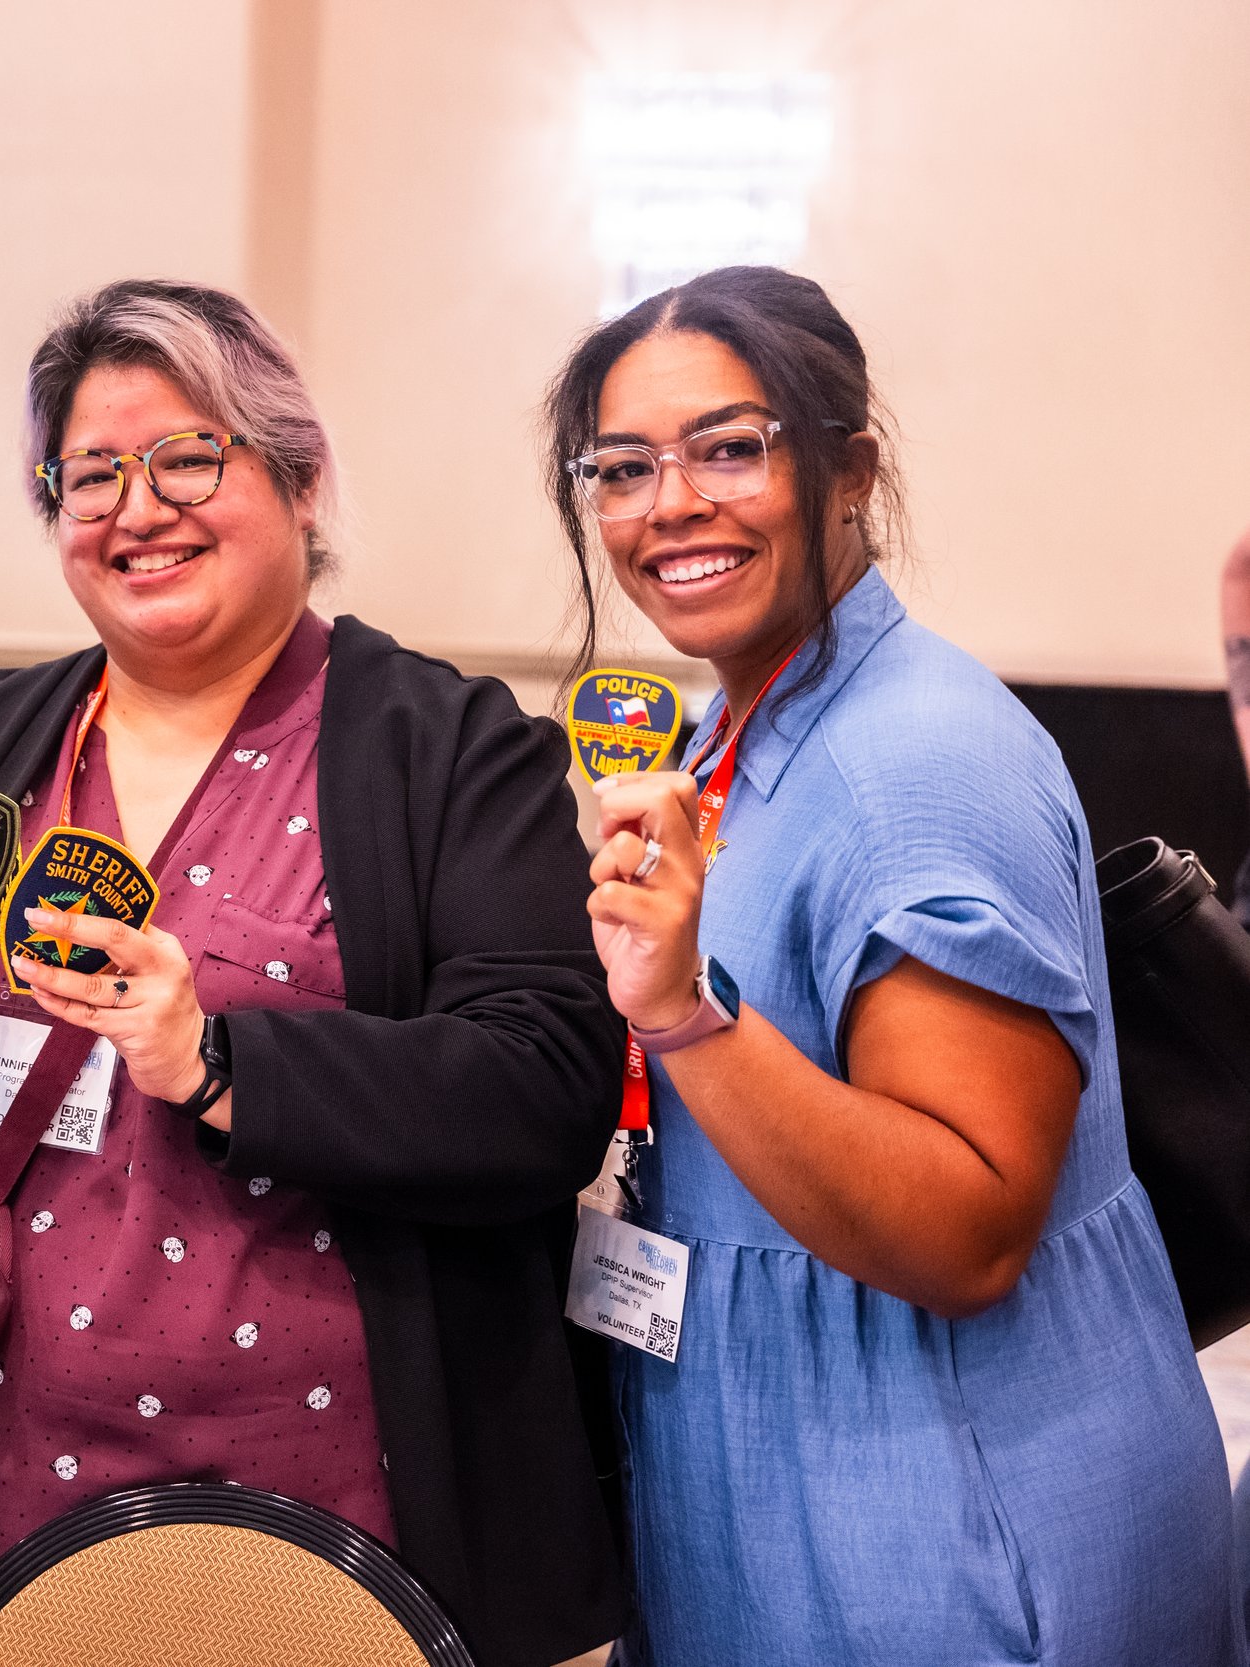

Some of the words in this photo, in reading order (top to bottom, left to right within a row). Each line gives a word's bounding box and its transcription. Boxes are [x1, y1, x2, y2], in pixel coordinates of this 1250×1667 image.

[596, 677, 663, 704] POLICE
[576, 730, 612, 741] GATEWAY
[619, 735, 630, 744] TO
[632, 738, 662, 749] MEXICO
[590, 747, 640, 776] LAREDO
[52, 839, 150, 905] SHERIFF
[46, 862, 91, 886] SMITH
[92, 878, 135, 922] COUNTY
[10, 941, 45, 963] TEX
[628, 1041, 643, 1079] CRI
[593, 1254, 630, 1277] JESSICA
[631, 1268, 666, 1292] WRIGHT
[609, 1290, 630, 1307] Dallas,
[632, 1300, 642, 1311] TX
[619, 1279, 653, 1300] Supervisor
[597, 1312, 646, 1340] VOLUNTEER
